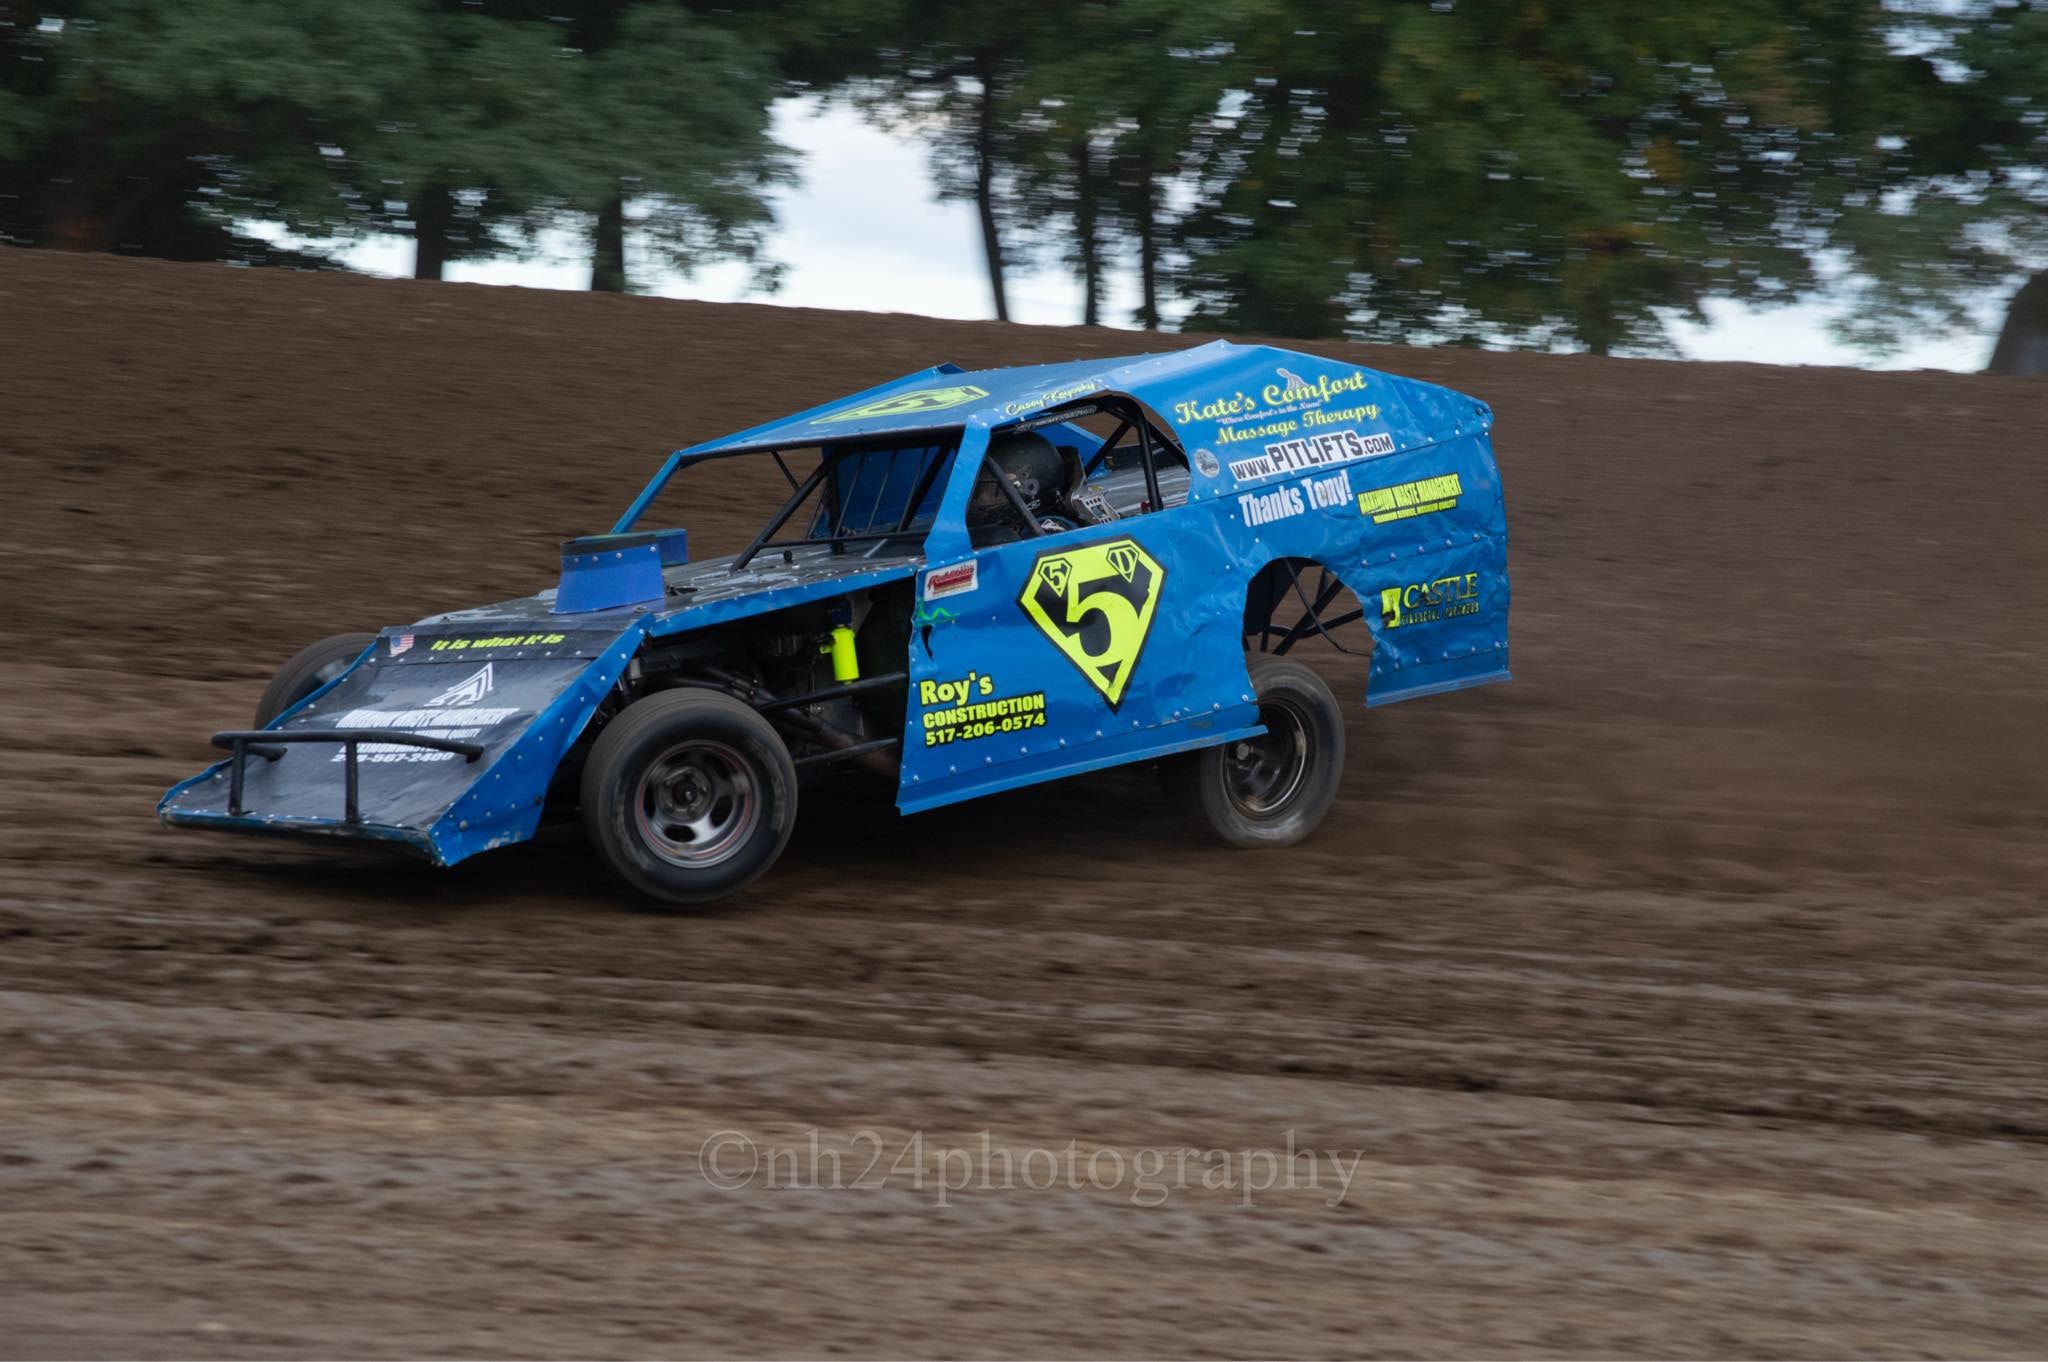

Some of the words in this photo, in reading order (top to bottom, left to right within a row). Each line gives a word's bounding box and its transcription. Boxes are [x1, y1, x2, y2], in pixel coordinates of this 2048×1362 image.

[1176, 392, 1255, 423] Kate's
[1264, 371, 1367, 405] Comfort
[1216, 421, 1297, 444] Massage
[1303, 404, 1378, 427] Therapy
[1238, 485, 1305, 527] Thanks
[1301, 470, 1353, 510] Tony!
[1049, 561, 1067, 588] 5
[1115, 549, 1135, 574] D
[1403, 572, 1478, 608] CASTLE
[471, 636, 524, 648] what
[541, 634, 565, 644] is
[920, 672, 993, 706] Roy's
[923, 694, 1045, 728] CONSTRUCTION
[925, 713, 1046, 746] 517-206-0574
